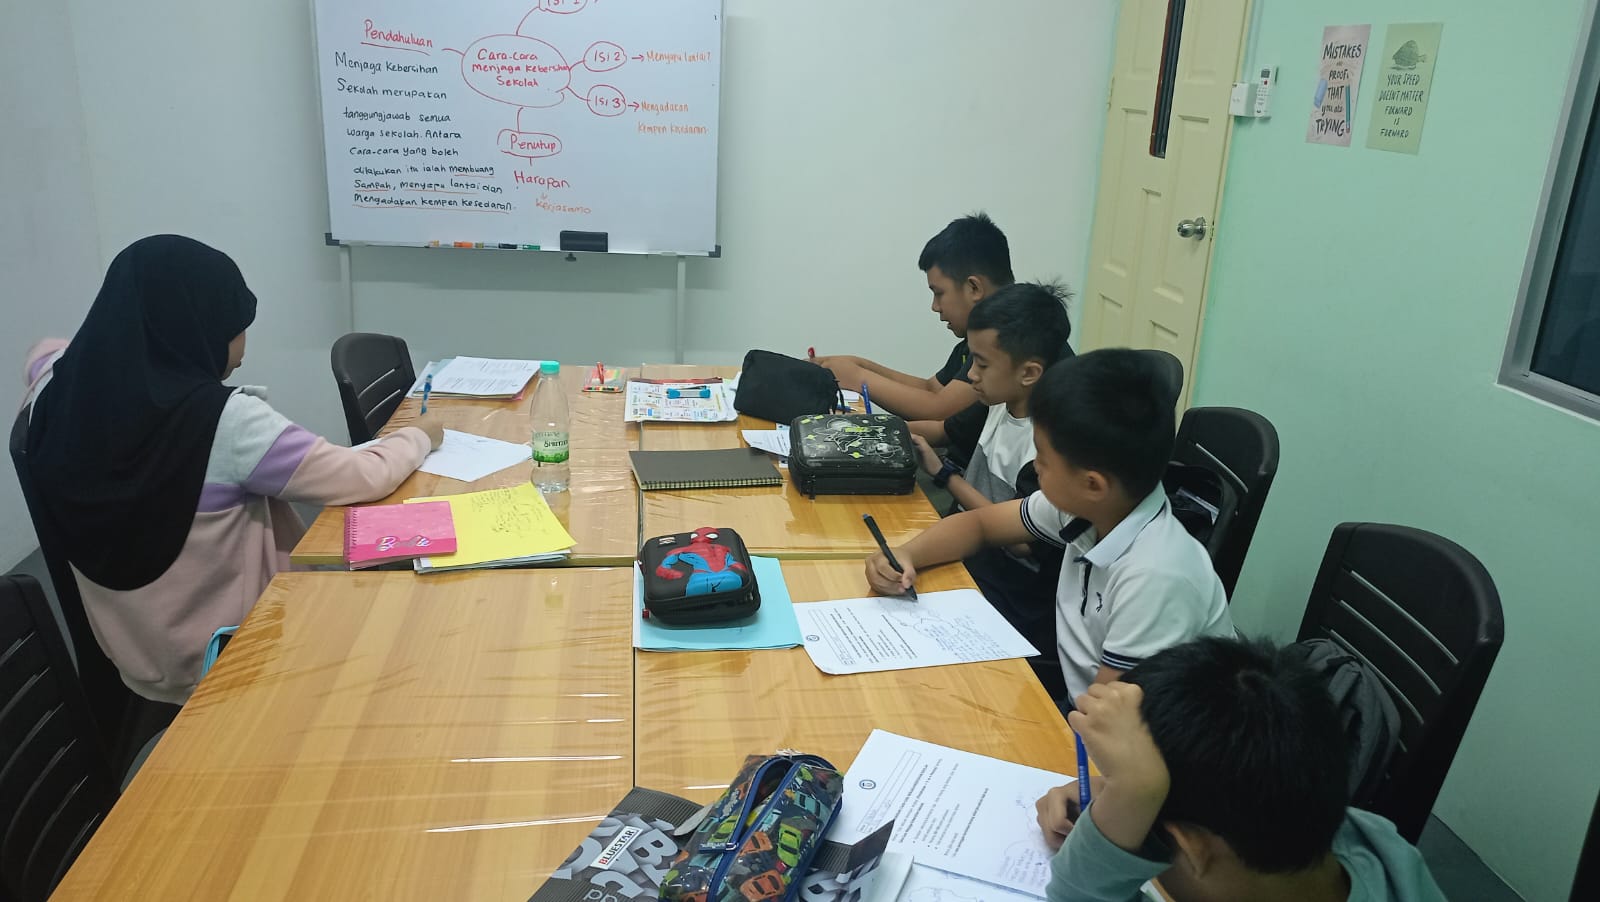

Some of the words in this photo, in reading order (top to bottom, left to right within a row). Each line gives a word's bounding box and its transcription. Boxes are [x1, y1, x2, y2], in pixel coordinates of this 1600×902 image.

[364, 19, 433, 48] Pendahuluan
[614, 51, 621, 61] 2
[1322, 42, 1362, 61] MISTAKES
[335, 51, 382, 75] Menjaga
[496, 75, 539, 87] Sekolah
[1402, 73, 1421, 86] SPEED
[1327, 85, 1345, 101] THAT
[1400, 90, 1424, 103] MATTER
[612, 97, 621, 108] 3
[343, 106, 411, 123] tanggungjawab
[1385, 105, 1413, 116] FORWARD
[425, 129, 462, 139] Antara
[1315, 117, 1345, 137] TRYING
[1380, 128, 1409, 138] FORWARD
[510, 133, 556, 152] Penutup
[431, 146, 460, 156] boleh
[353, 166, 402, 177] dilakukan
[450, 178, 481, 190] lantai
[481, 185, 503, 194] dan
[513, 170, 571, 191] Harapan
[598, 829, 635, 866] BLUESTAR
